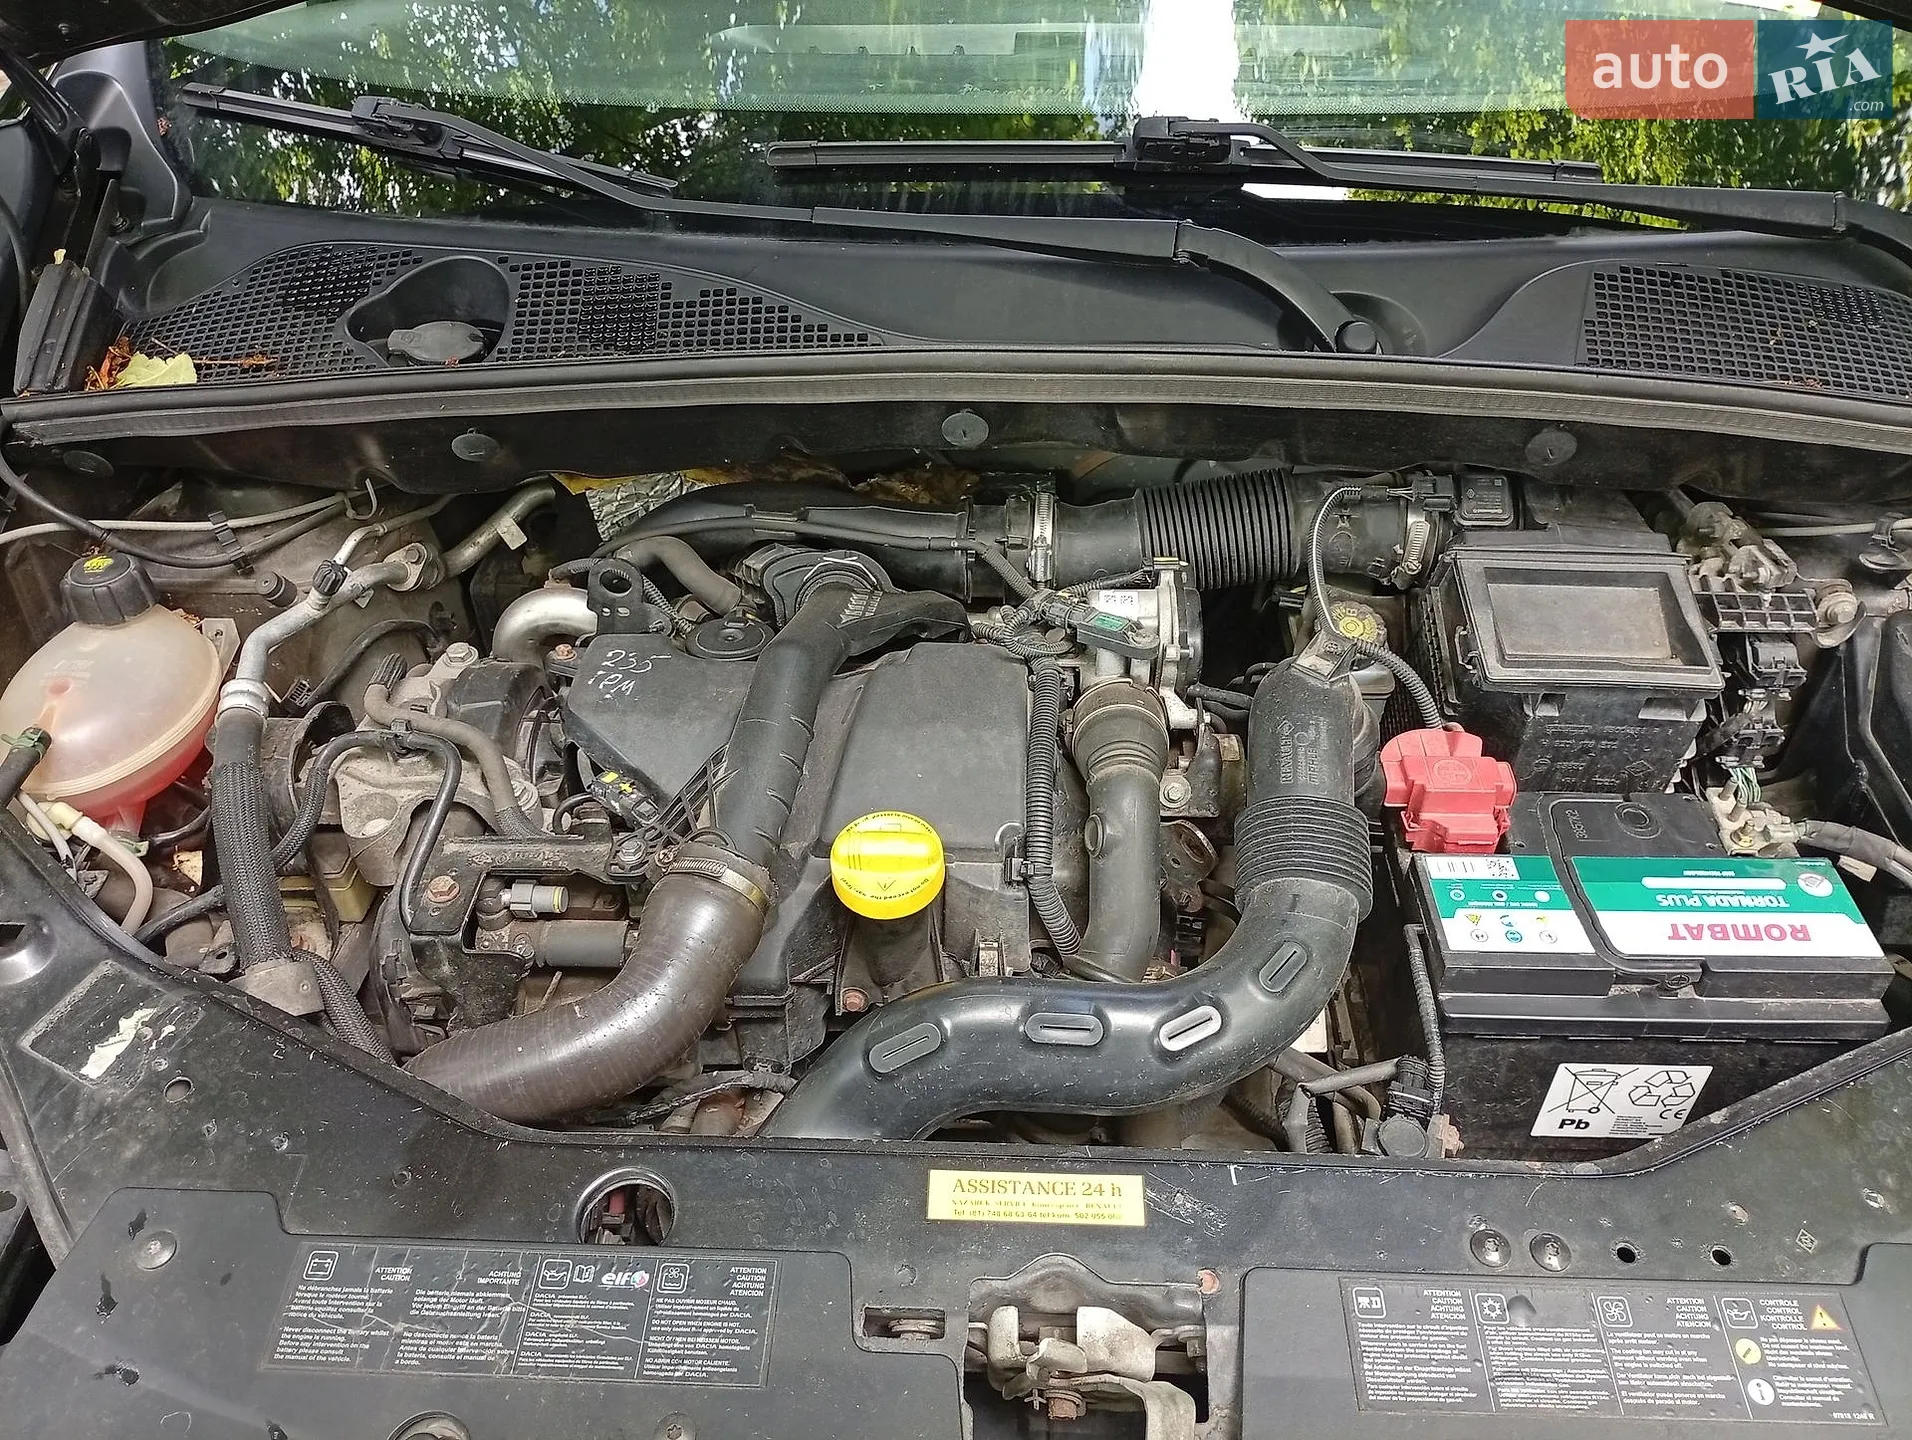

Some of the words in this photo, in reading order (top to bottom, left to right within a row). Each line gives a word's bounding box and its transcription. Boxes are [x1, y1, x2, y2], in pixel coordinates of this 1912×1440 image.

[601, 650, 672, 673] 235
[1656, 894, 1702, 907] PLUS
[1702, 894, 1790, 908] TORNADA
[1668, 923, 1811, 941] ROMBAT
[1558, 1118, 1590, 1130] Pb
[953, 1178, 1076, 1196] ASSISTANCE
[1082, 1181, 1105, 1197] 24
[1111, 1183, 1122, 1197] h
[375, 1267, 413, 1275] ATTENTION
[477, 1277, 520, 1285] IMPORTANTE
[601, 1271, 633, 1285] elf
[1759, 1299, 1799, 1307] CONTROLE
[1766, 1307, 1802, 1315] CONTROL
